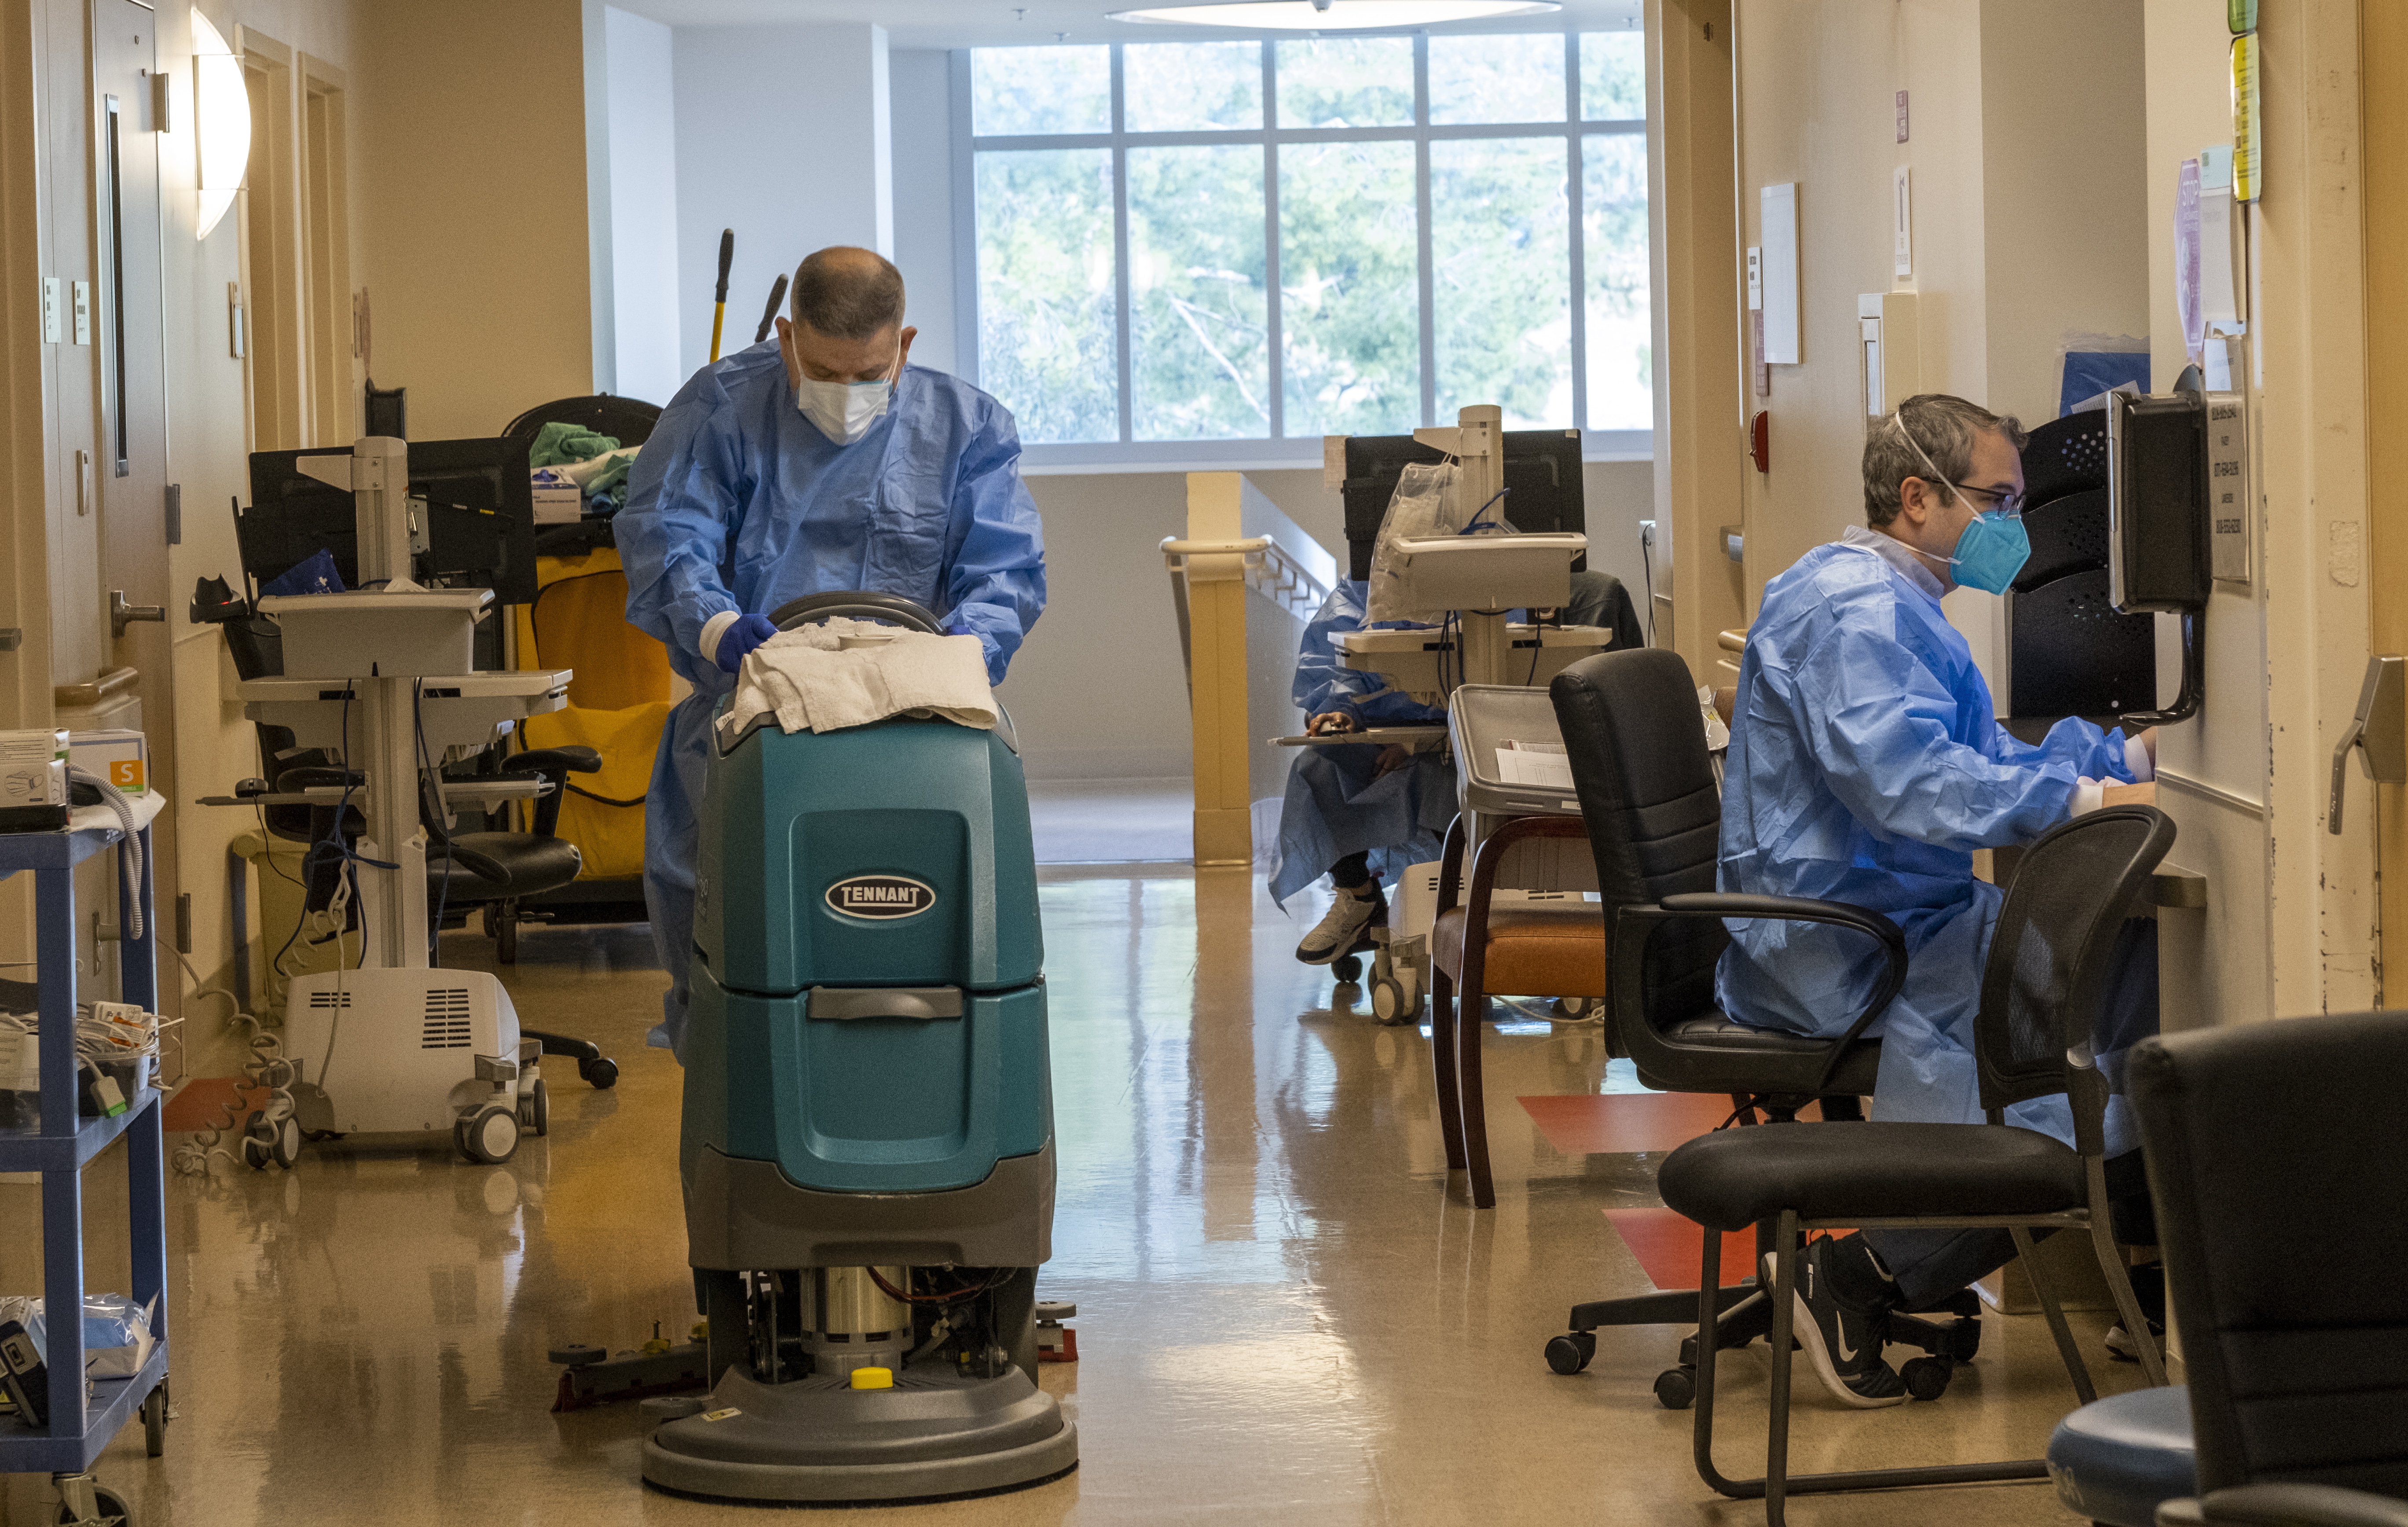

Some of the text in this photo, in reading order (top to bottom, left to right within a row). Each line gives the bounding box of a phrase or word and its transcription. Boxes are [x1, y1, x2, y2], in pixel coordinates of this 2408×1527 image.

[2183, 180, 2198, 206] STOP
[121, 764, 134, 782] S
[841, 887, 920, 907] TENNANT
